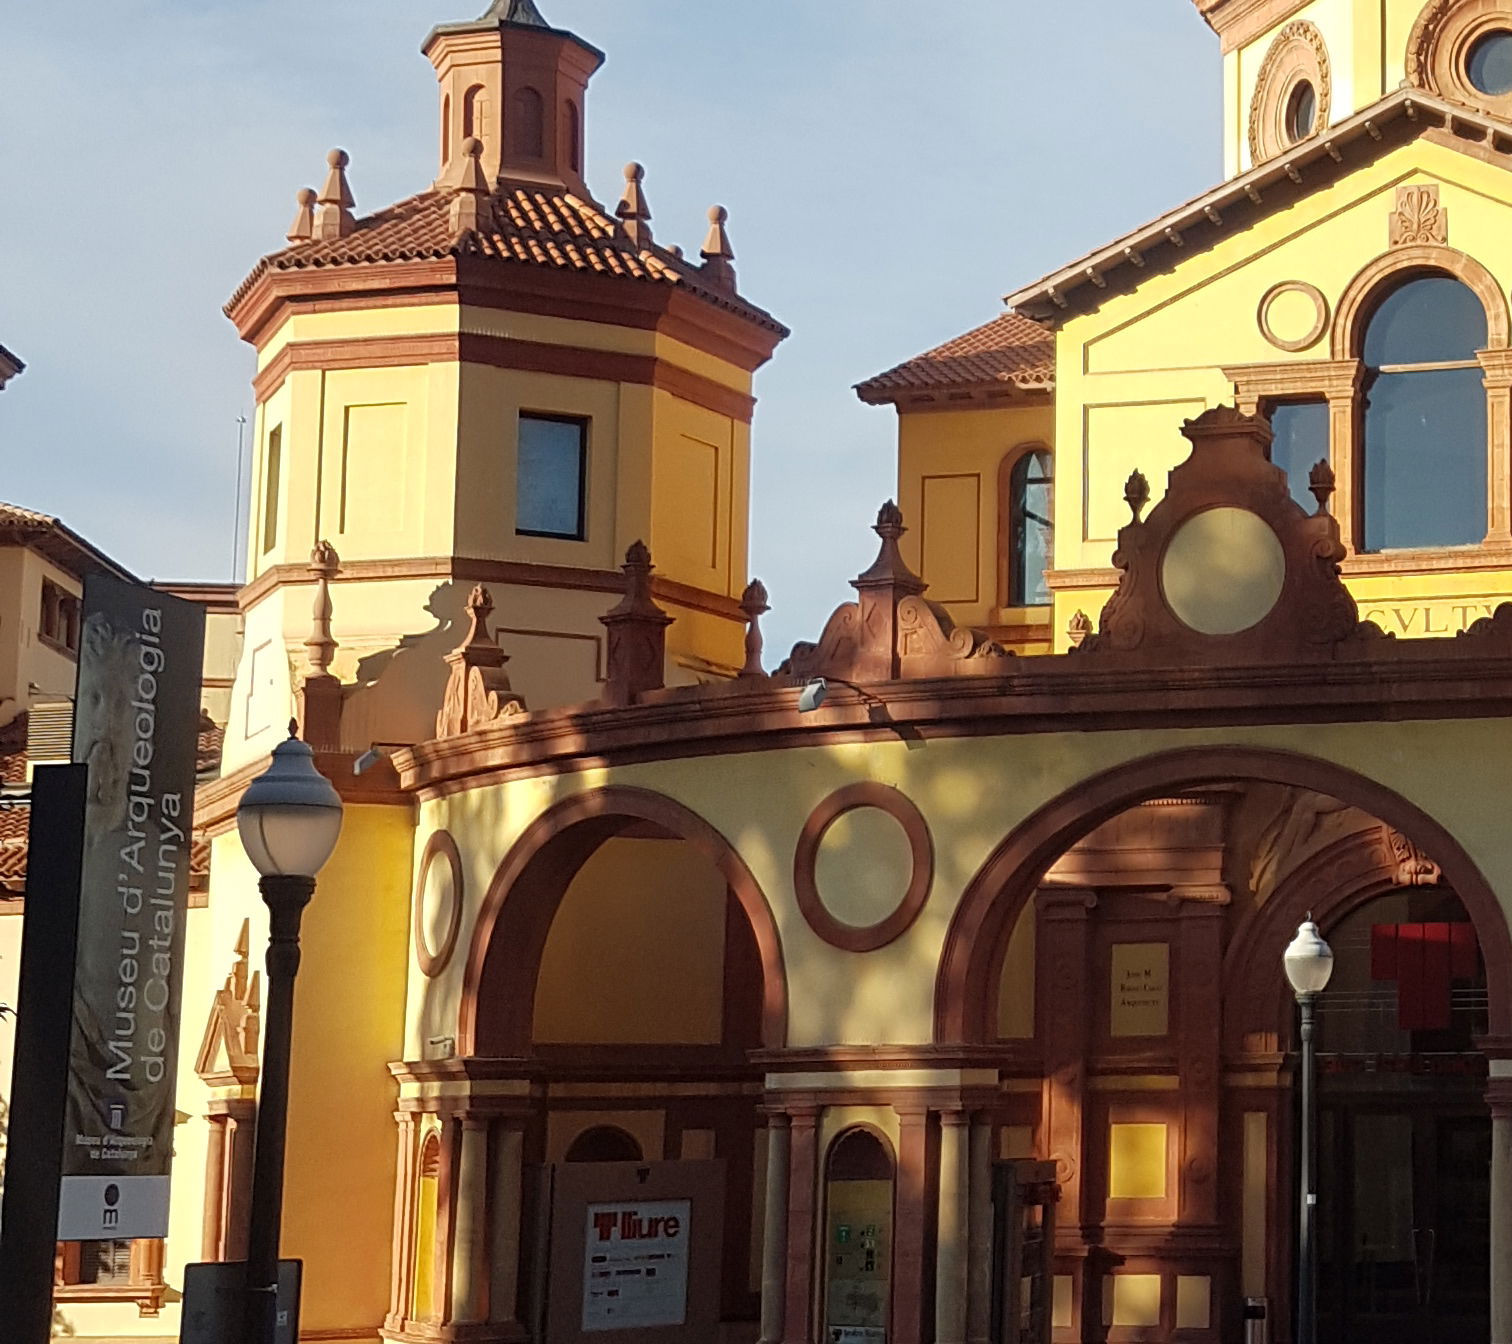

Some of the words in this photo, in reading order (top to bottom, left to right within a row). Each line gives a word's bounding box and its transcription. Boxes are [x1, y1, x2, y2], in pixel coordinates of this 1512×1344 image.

[117, 608, 165, 914] d'Arqueologia
[143, 792, 185, 1012] Catalunya
[106, 930, 141, 1081] Museu
[140, 1026, 166, 1083] de
